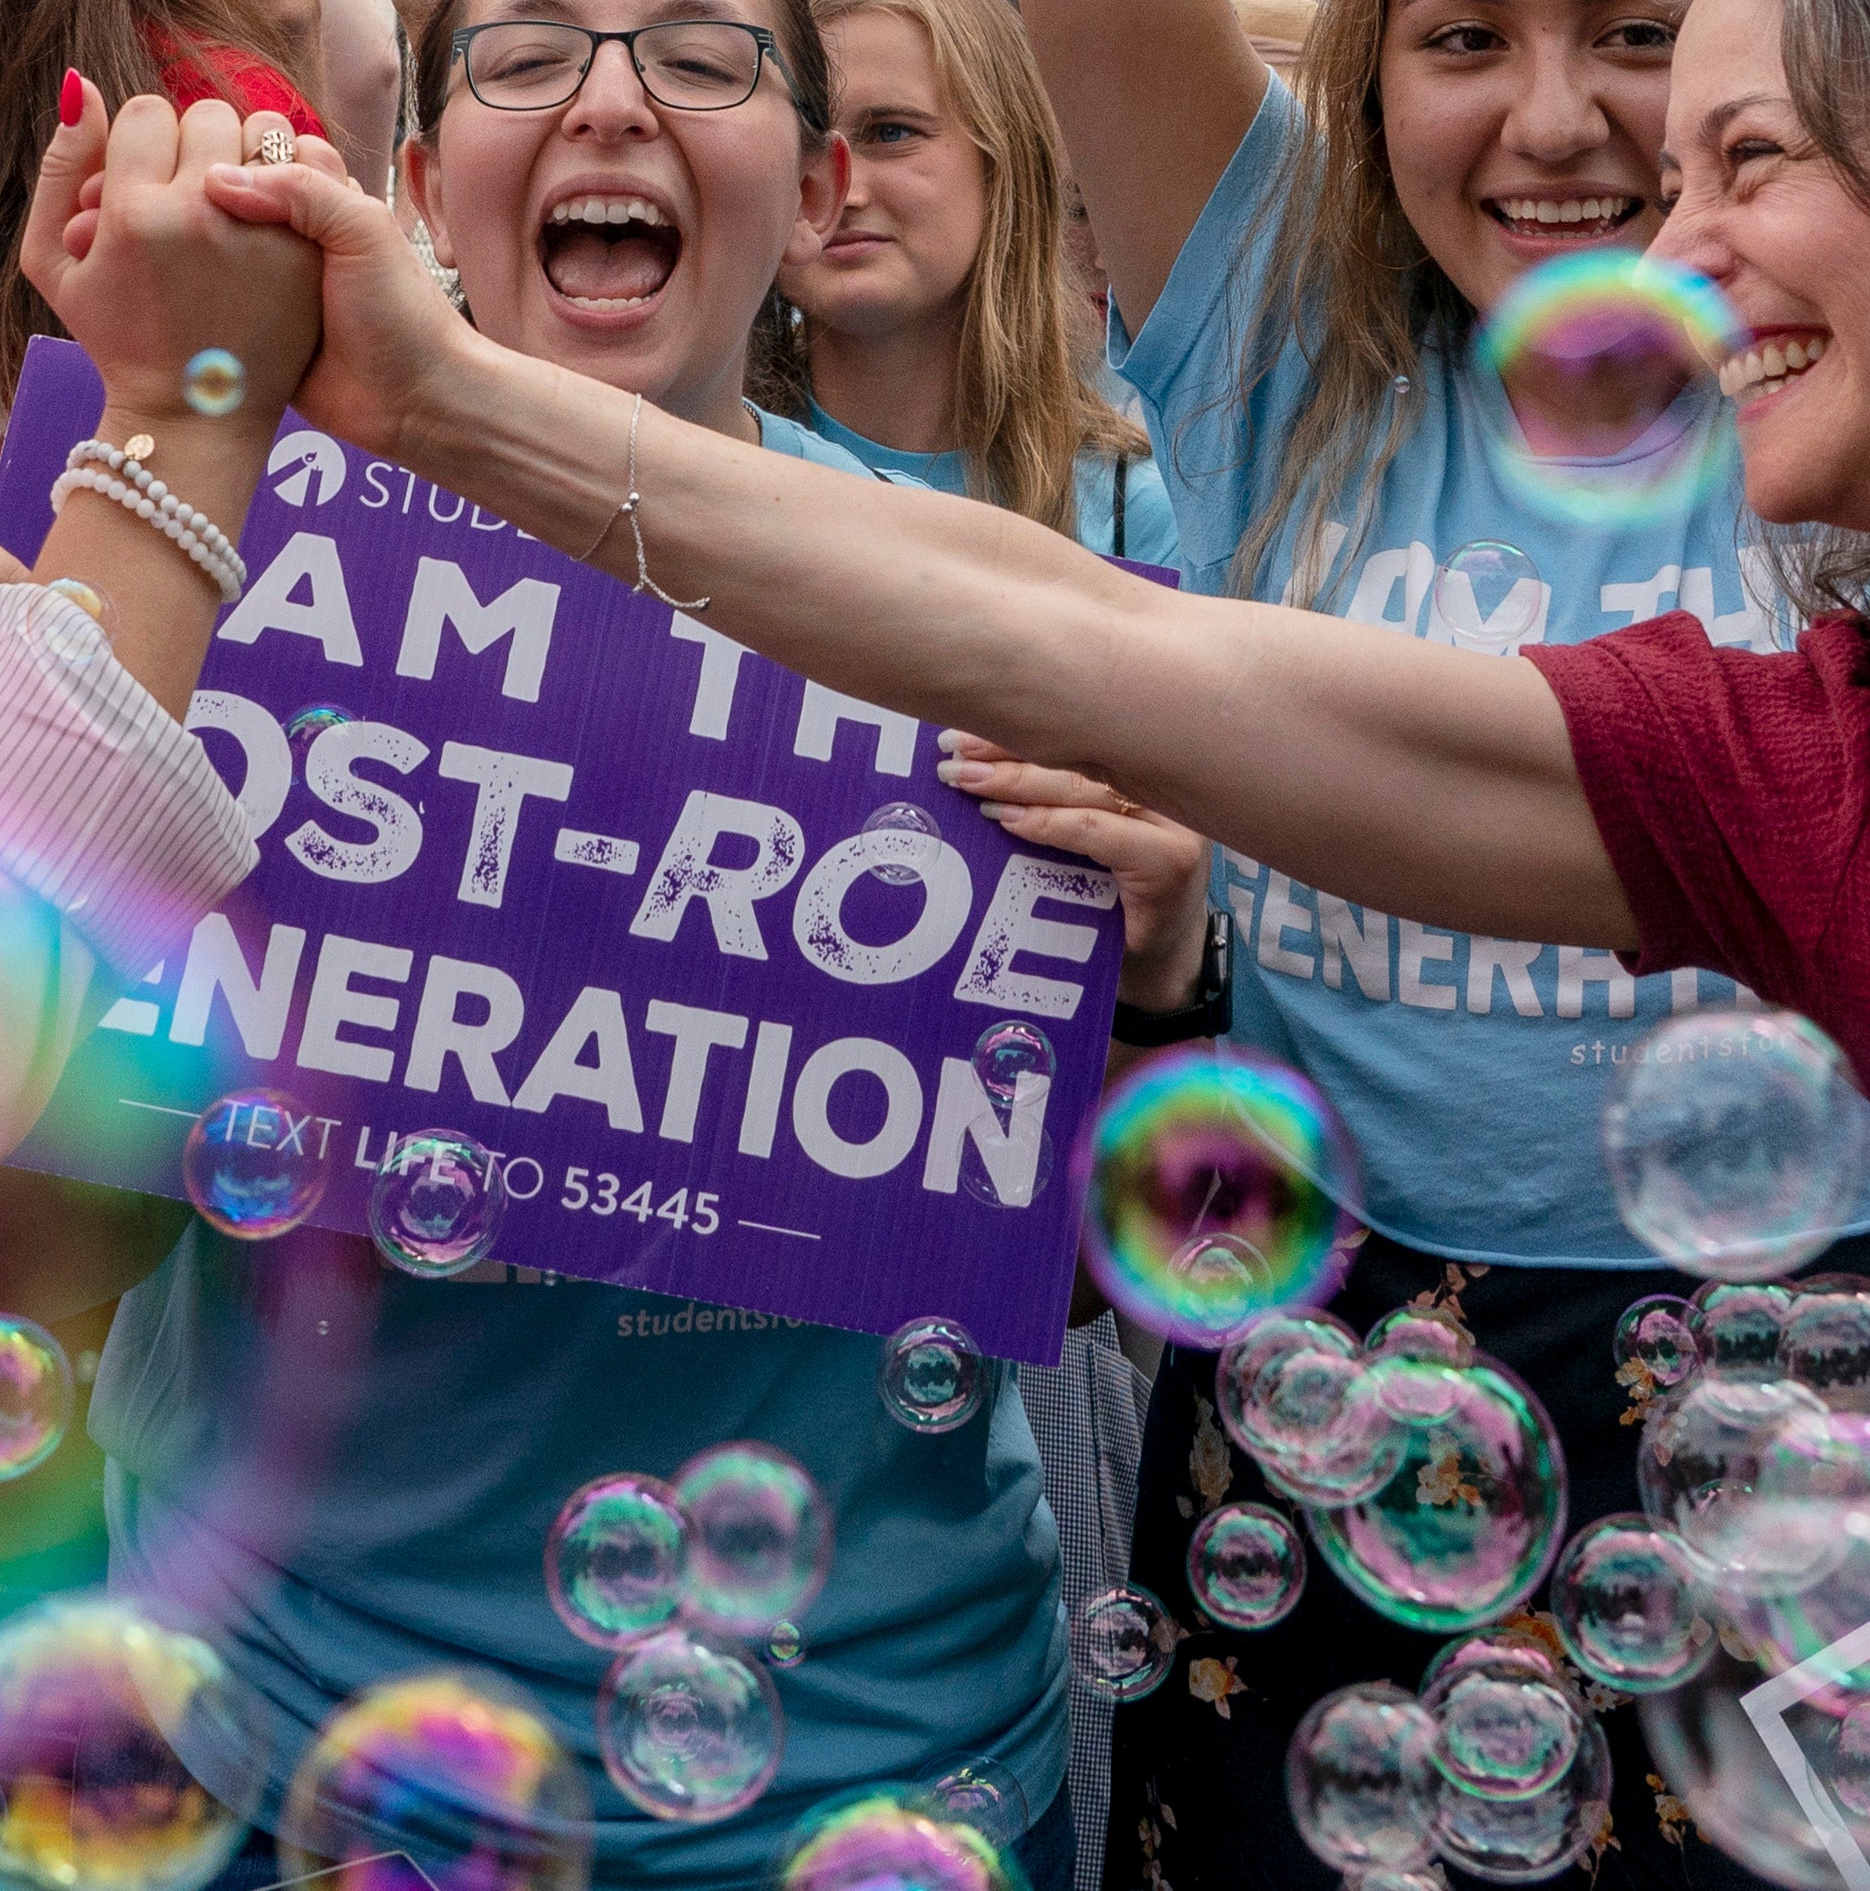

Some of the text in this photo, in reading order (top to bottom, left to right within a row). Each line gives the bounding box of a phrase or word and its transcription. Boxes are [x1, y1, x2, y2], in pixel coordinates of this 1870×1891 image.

[216, 530, 563, 704] AM
[223, 1099, 721, 1235] TEXT LIFE TO 53445
